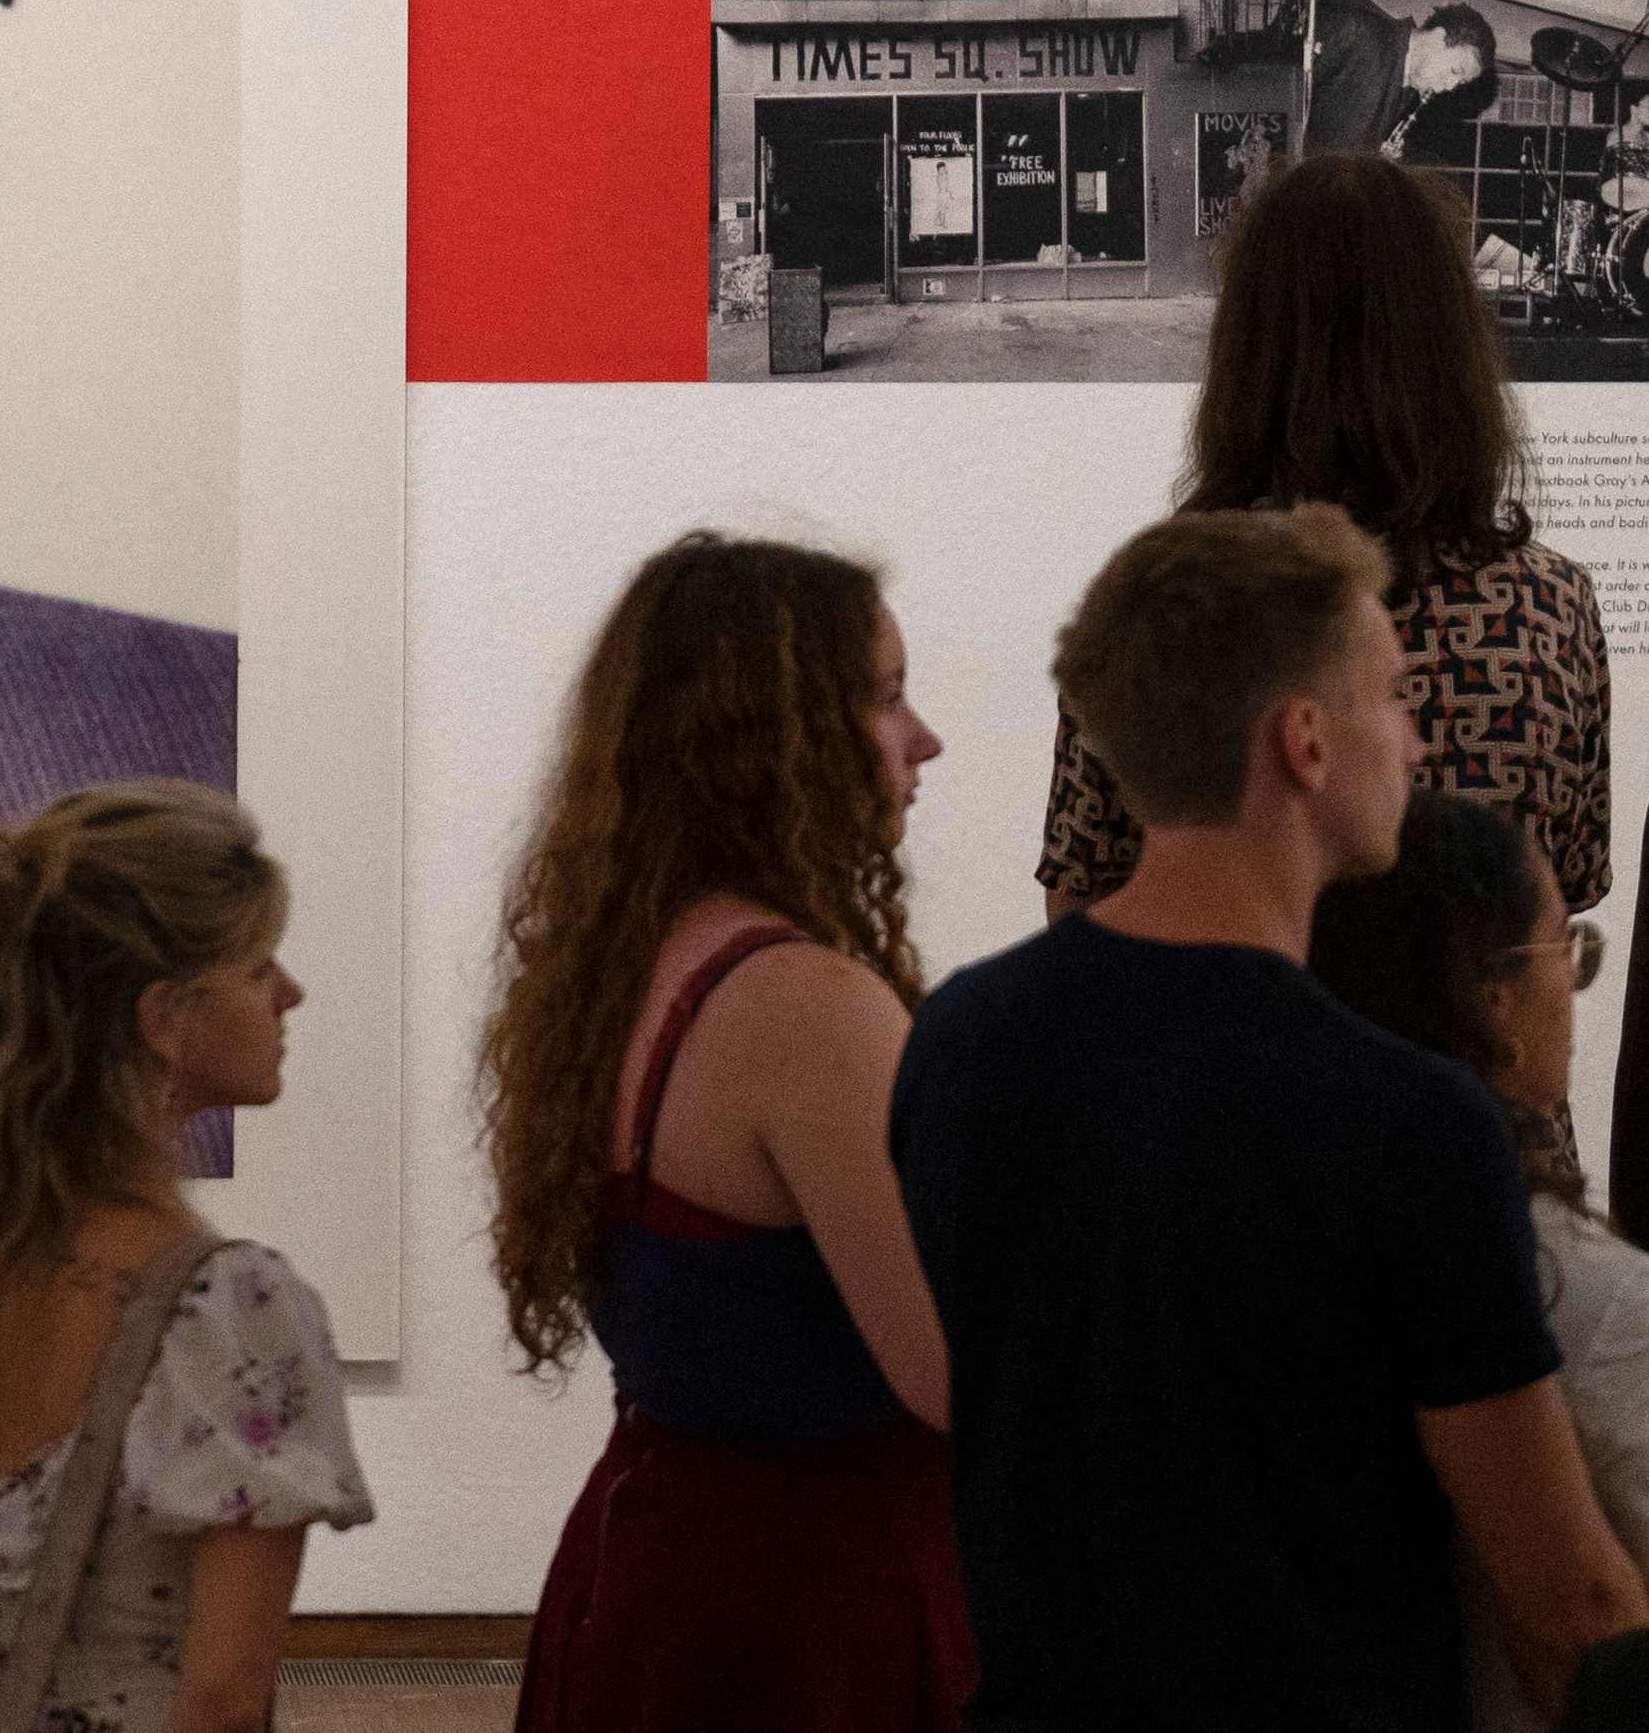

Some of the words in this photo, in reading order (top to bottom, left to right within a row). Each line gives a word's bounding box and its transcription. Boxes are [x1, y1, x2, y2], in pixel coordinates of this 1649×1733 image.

[765, 34, 912, 82] TIMES
[934, 36, 1003, 83] SQ.
[1018, 32, 1142, 78] SHOW
[1204, 113, 1281, 133] MOVIES
[997, 170, 1055, 187] EXHIBITION
[1542, 431, 1569, 444] York
[1572, 431, 1637, 444] subculture
[1567, 452, 1632, 465] instrument
[1594, 494, 1611, 507] his
[1547, 515, 1585, 528] heads
[1589, 515, 1615, 528] and
[1605, 580, 1640, 591] order
[1602, 600, 1632, 612] Club
[1619, 621, 1640, 633] will
